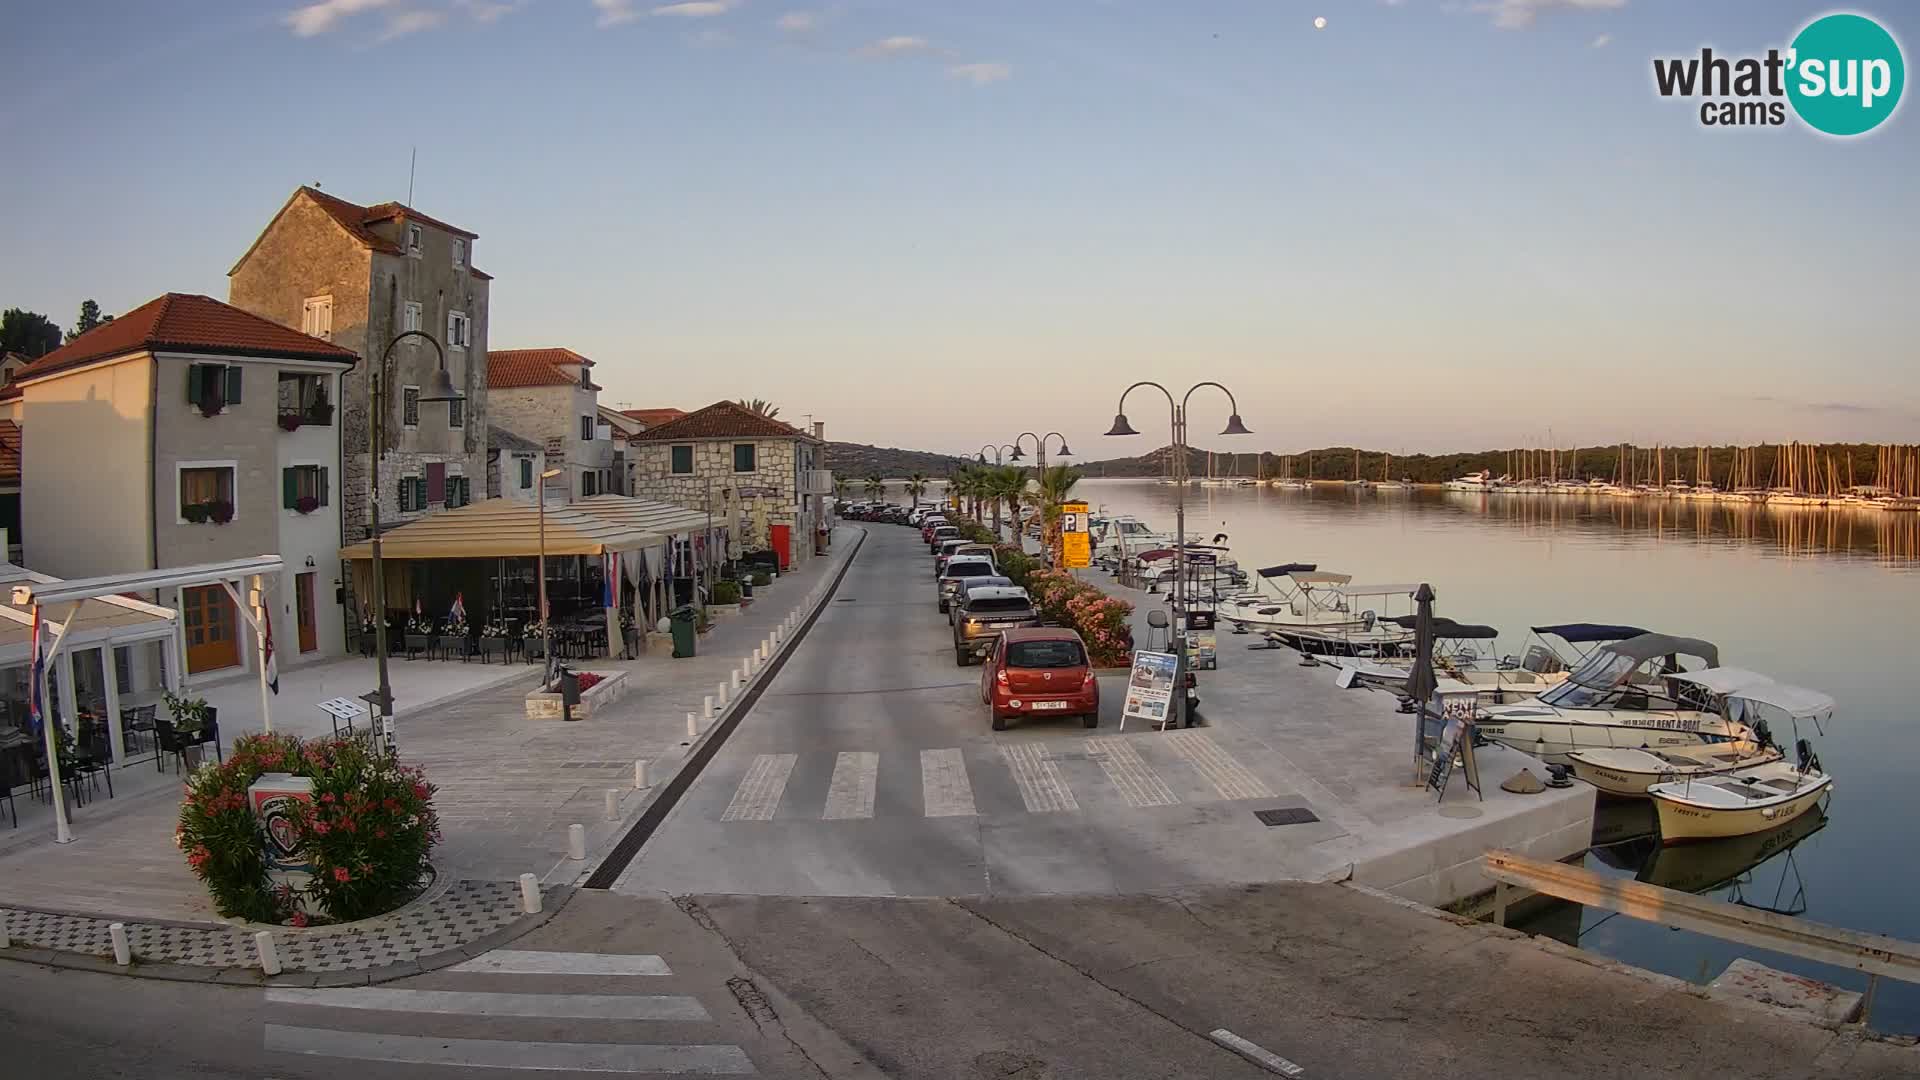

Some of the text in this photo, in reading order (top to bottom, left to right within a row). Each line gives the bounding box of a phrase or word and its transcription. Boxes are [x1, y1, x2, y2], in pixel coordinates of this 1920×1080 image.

[1065, 514, 1075, 530] P
[1443, 698, 1475, 711] RENT
[1657, 720, 1675, 729] RENT
